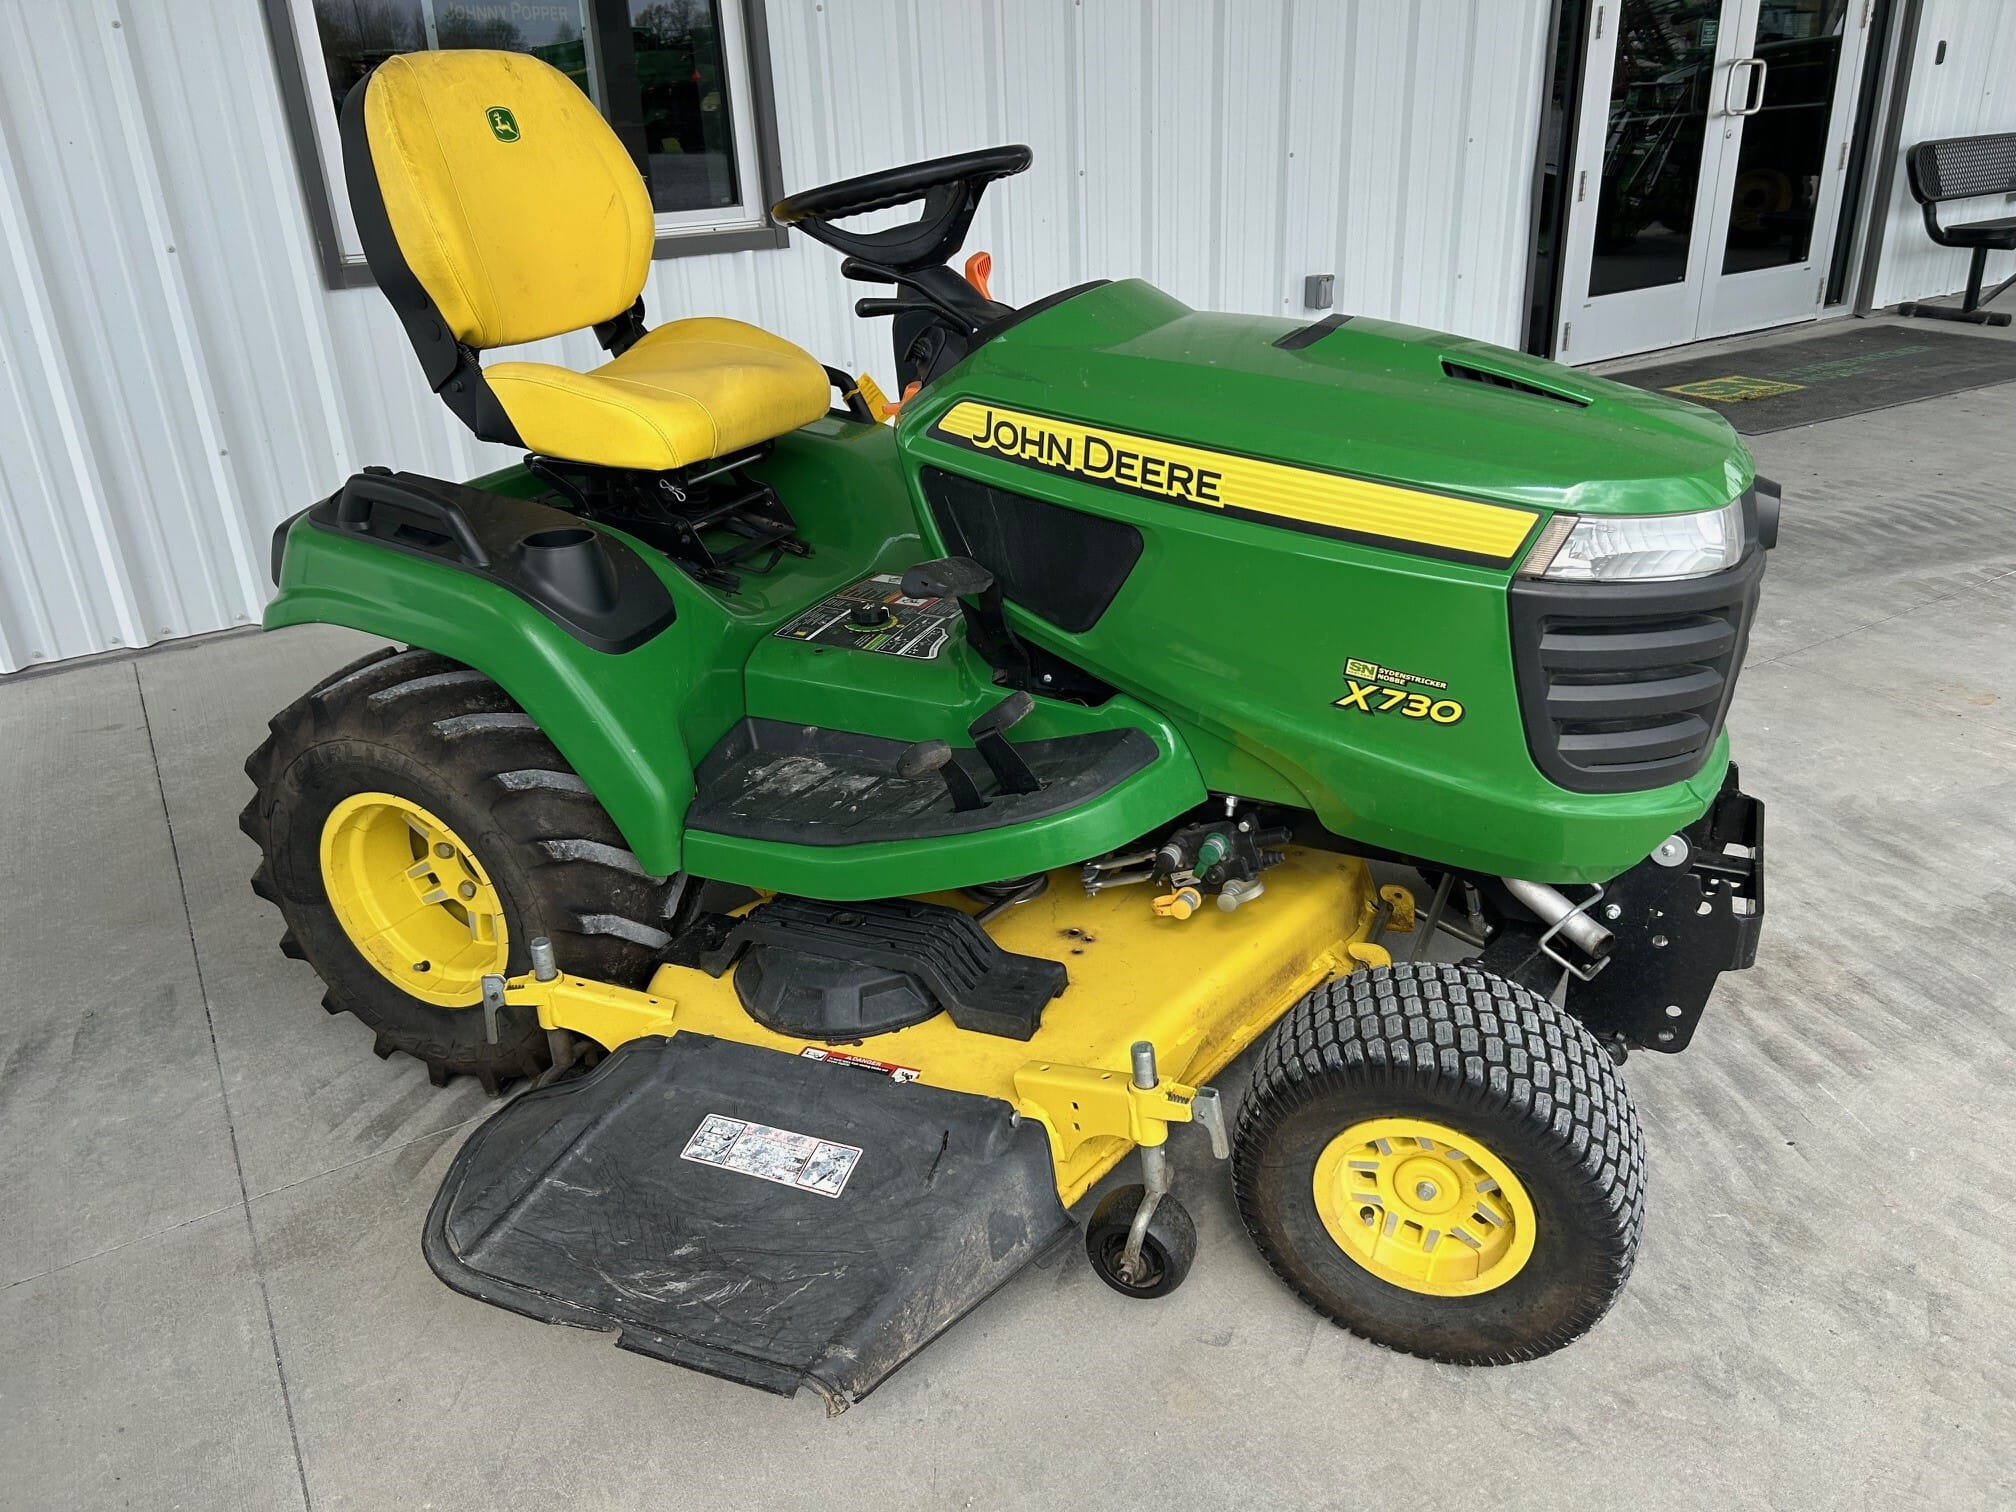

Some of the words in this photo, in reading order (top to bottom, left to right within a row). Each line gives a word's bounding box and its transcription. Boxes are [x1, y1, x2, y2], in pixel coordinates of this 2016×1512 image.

[444, 2, 507, 20] JOHNNY
[510, 2, 569, 21] POPPER
[971, 410, 1073, 468] JOHN
[1083, 435, 1223, 503] DEERE
[1348, 661, 1376, 677] SN
[1378, 667, 1448, 689] SYDENSTRICKER
[1377, 674, 1406, 686] NOBBE
[1335, 680, 1464, 723] X730
[852, 1056, 882, 1067] DANGER
